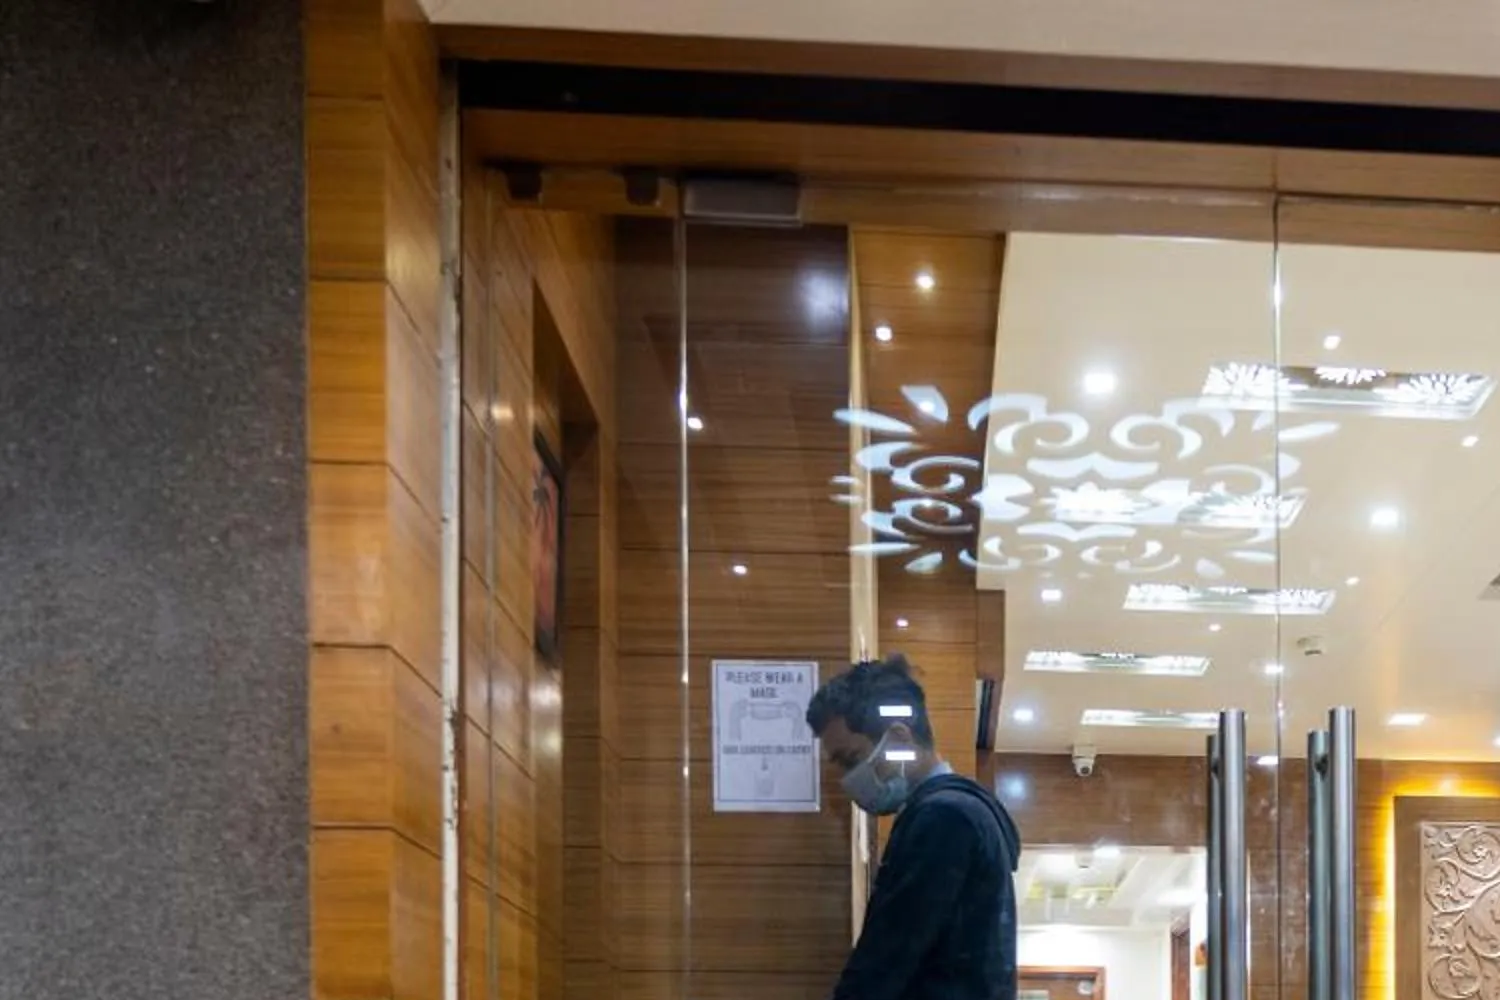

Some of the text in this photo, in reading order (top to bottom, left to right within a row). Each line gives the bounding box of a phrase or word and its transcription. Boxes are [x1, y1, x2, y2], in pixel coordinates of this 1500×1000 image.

[725, 671, 804, 685] PLEASE WEAR A
